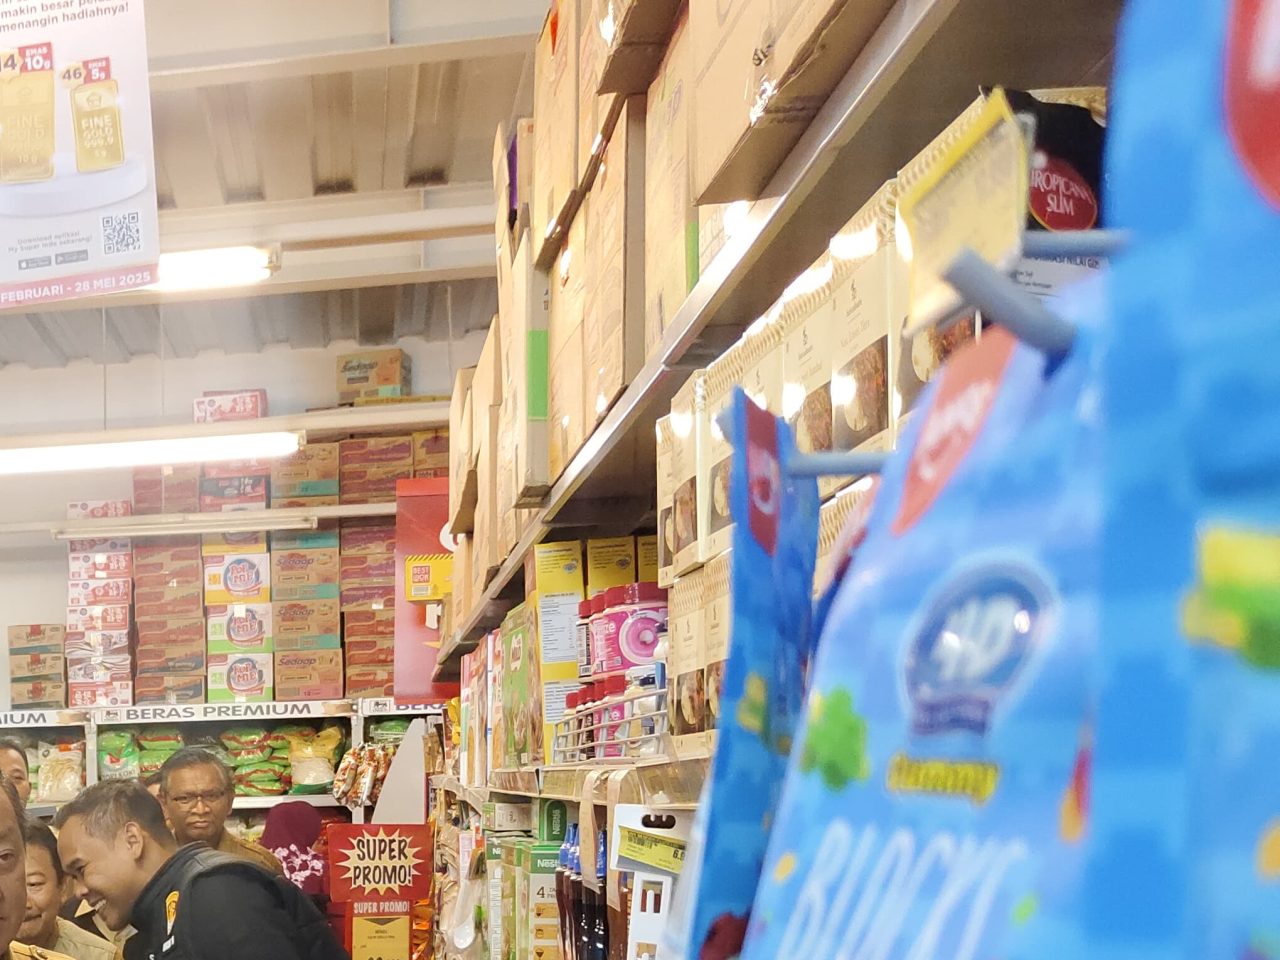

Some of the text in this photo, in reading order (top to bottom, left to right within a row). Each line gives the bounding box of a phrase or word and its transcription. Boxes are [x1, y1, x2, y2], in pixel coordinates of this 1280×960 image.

[0, 4, 38, 19] makin
[41, 0, 75, 12] besar
[62, 3, 129, 23] hadiahnya!
[25, 56, 51, 71] 10g
[62, 68, 82, 81] 46
[81, 114, 112, 129] FINE
[1046, 193, 1075, 216] SLIM
[0, 285, 64, 303] FEBRUARI
[74, 281, 90, 292] 28
[93, 278, 115, 289] MEI
[119, 272, 151, 286] 2025
[278, 655, 317, 667] Sedaap
[125, 703, 312, 721] BERAS PREMIUM
[395, 700, 445, 711] BERA
[356, 838, 409, 862] SUPER
[352, 864, 413, 888] PROMO!
[536, 886, 545, 899] 4
[353, 901, 410, 914] SUPER PROMO!
